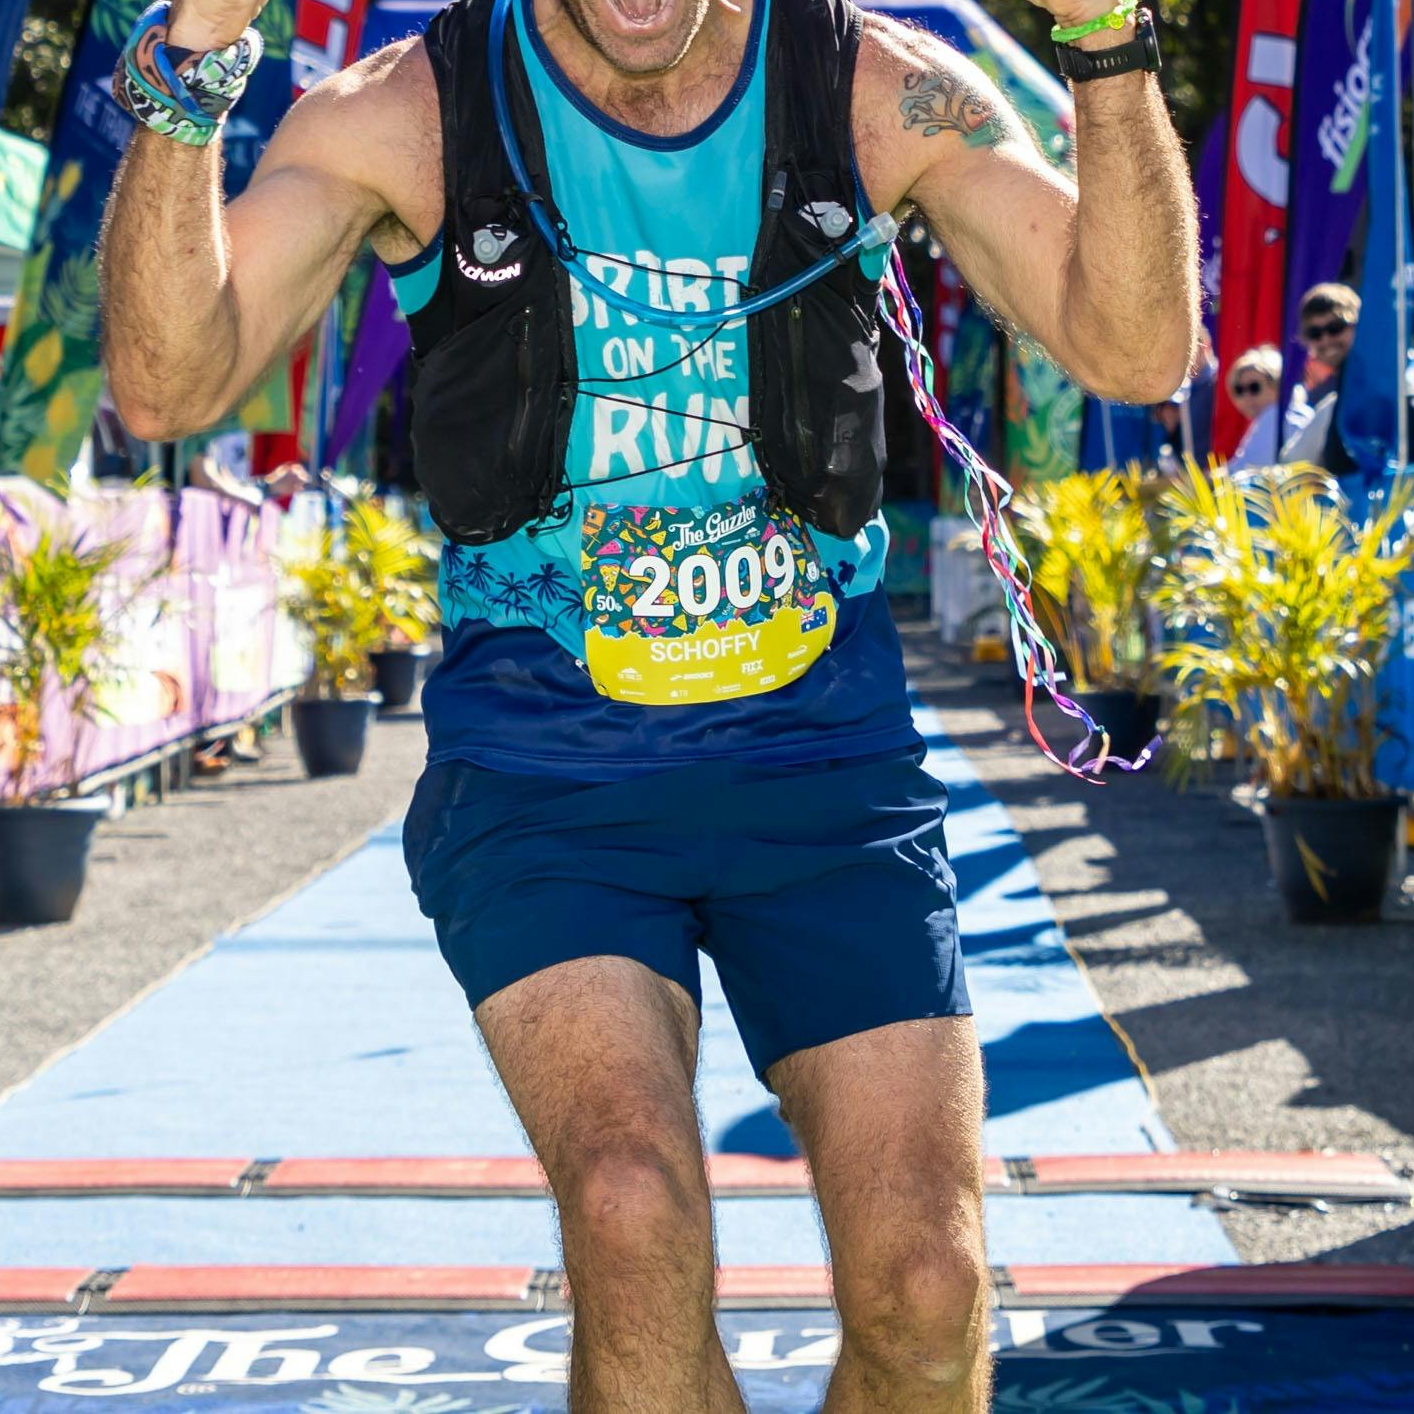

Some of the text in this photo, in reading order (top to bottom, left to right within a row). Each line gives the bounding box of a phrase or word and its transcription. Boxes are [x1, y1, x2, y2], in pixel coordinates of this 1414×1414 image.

[602, 334, 737, 382] ON THE
[588, 392, 756, 485] RUN
[667, 520, 705, 552] The
[705, 505, 757, 543] Guzzler
[628, 534, 796, 618] 2009
[649, 629, 761, 663] SCHOFFY
[31, 1322, 436, 1396] The
